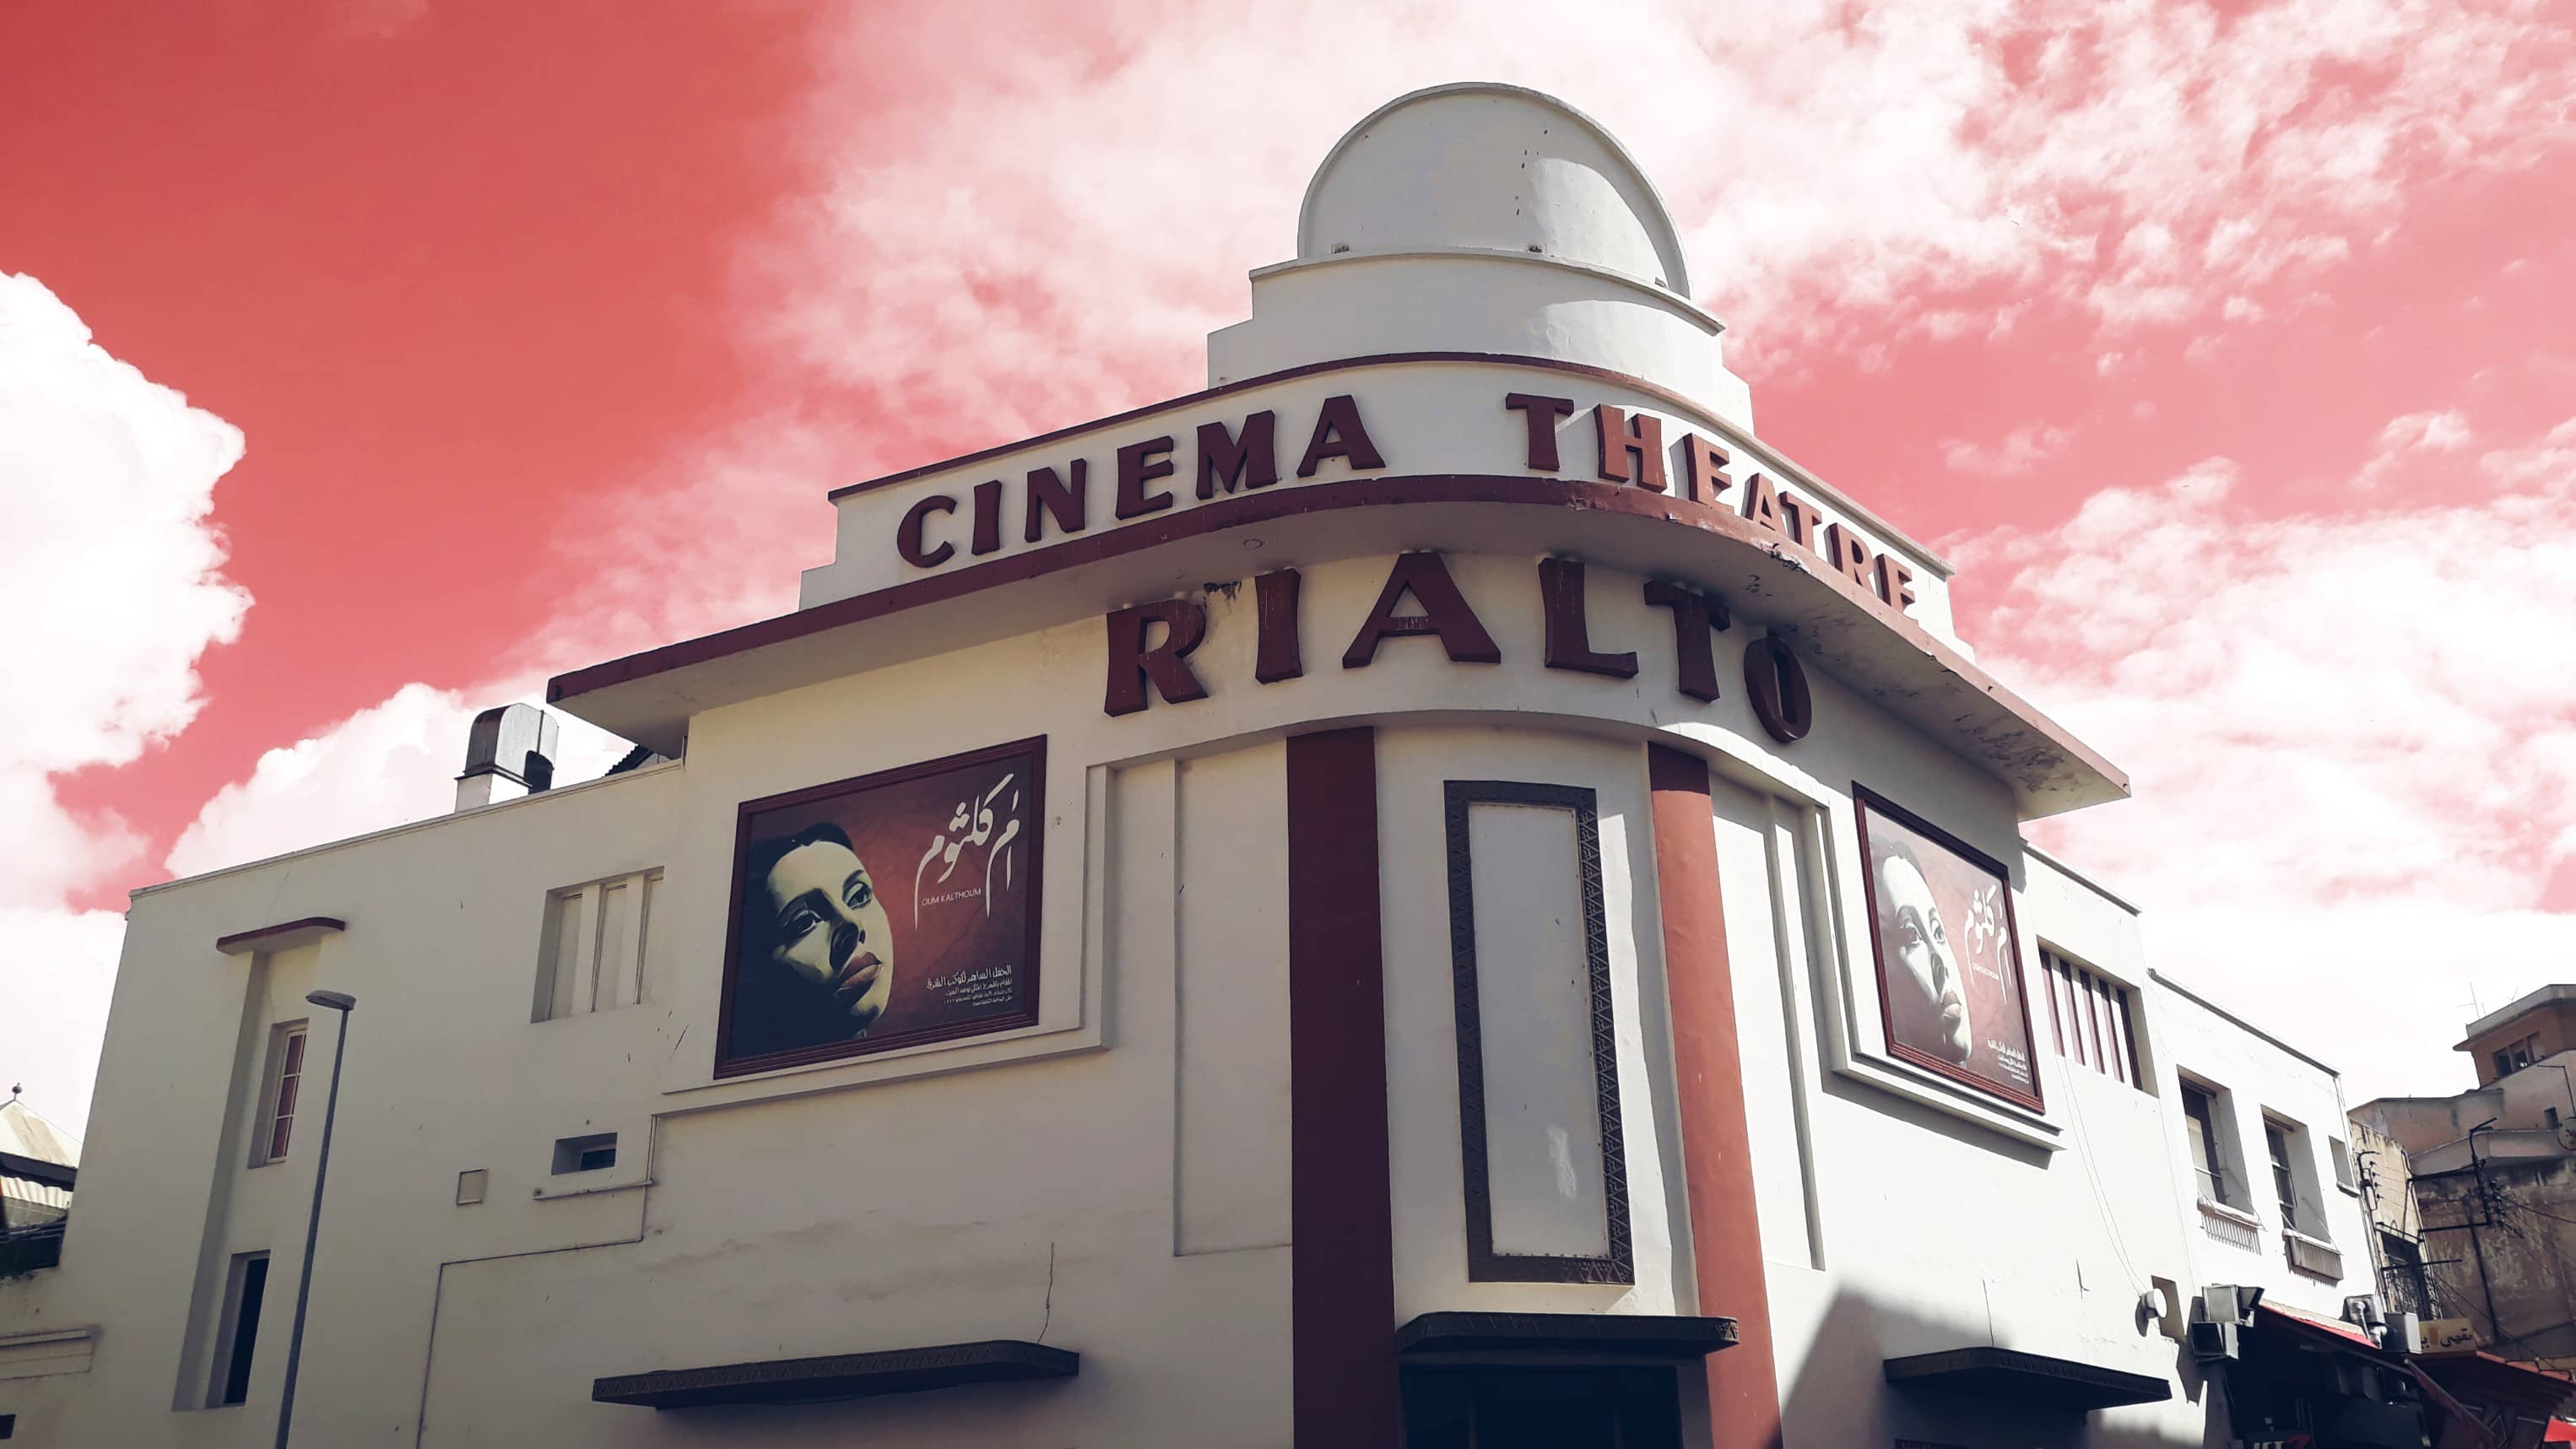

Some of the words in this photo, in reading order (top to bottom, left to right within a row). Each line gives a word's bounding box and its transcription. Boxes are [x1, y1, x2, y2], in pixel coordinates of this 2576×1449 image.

[896, 394, 1386, 569] CINEMA
[1505, 392, 1918, 626] THEATRE
[1103, 549, 1812, 743] RIALTO
[914, 773, 1015, 932] كلثوم
[921, 897, 940, 906] OUM
[940, 887, 982, 903] KALTHOUM
[992, 964, 1012, 979] الحفل
